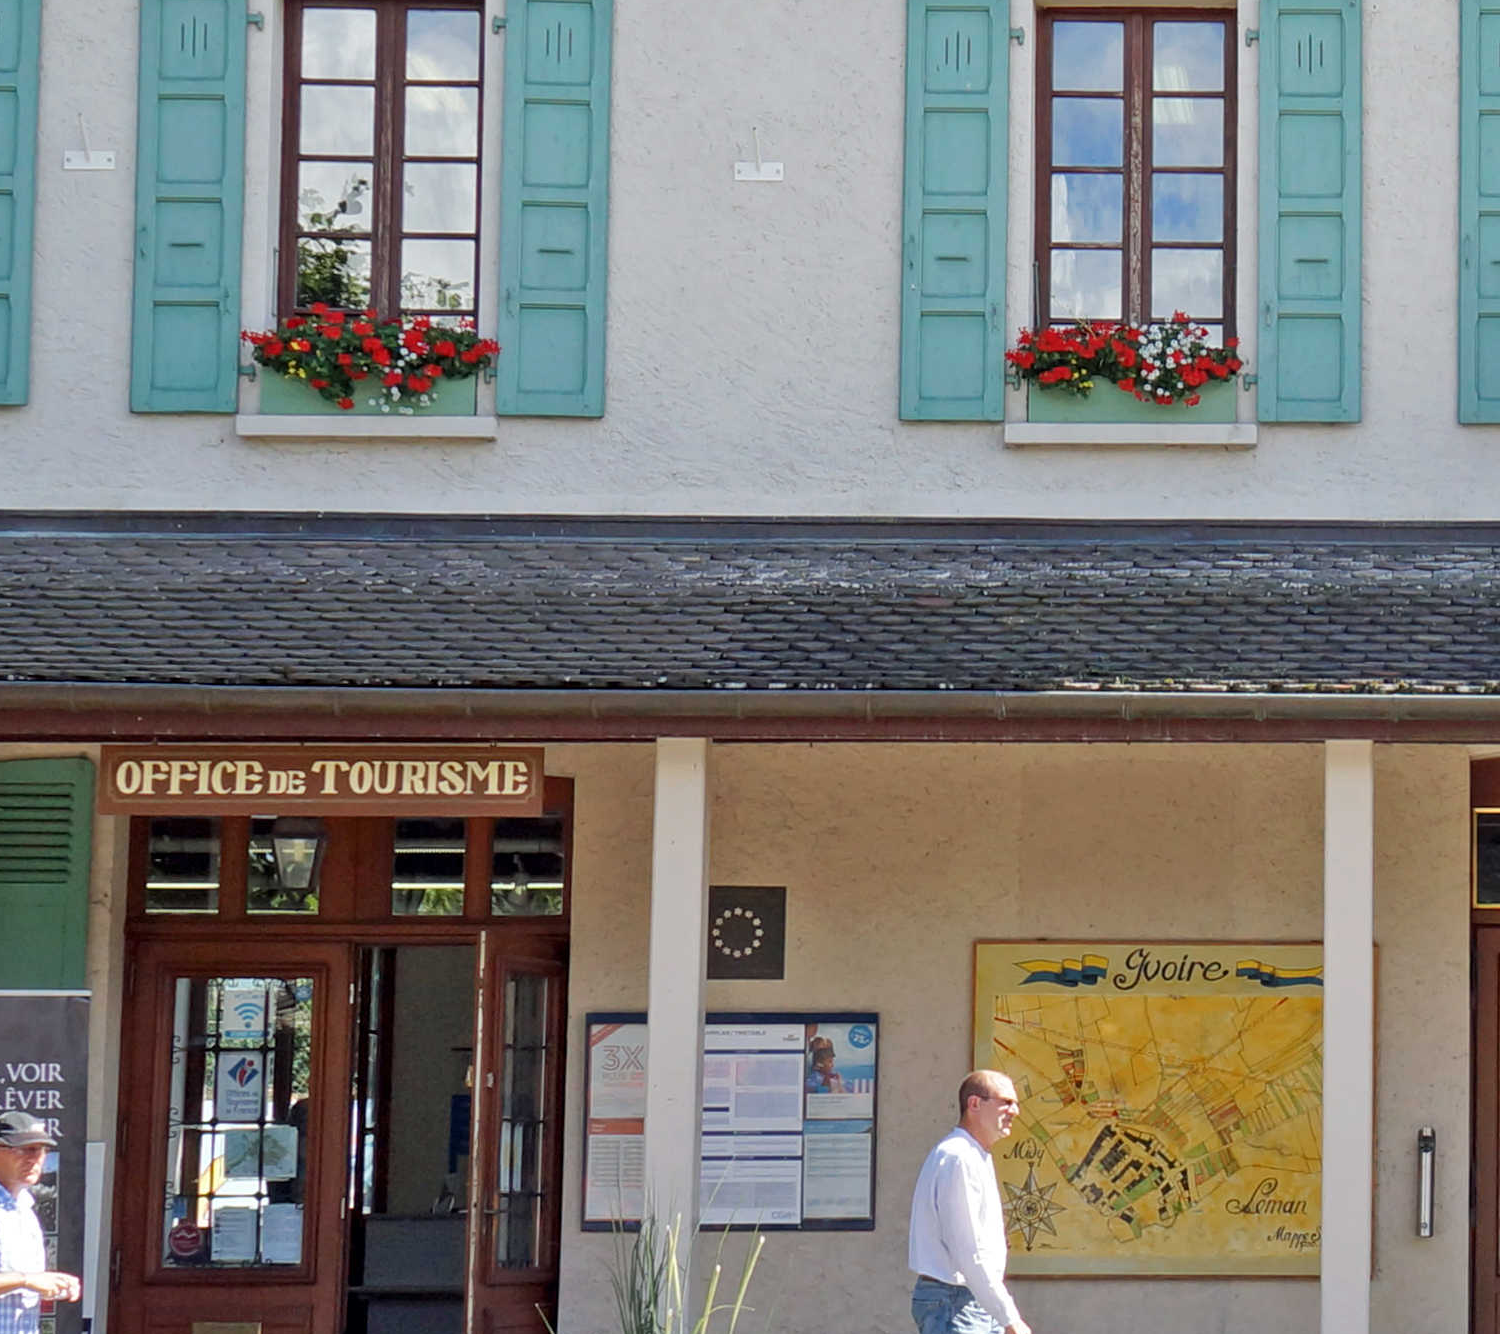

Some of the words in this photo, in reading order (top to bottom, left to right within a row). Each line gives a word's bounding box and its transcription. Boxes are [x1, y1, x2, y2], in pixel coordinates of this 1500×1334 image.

[115, 760, 263, 795] OFFICE
[267, 770, 306, 795] DE
[311, 760, 528, 795] TOURISME
[1113, 948, 1229, 990] Yvoire
[5, 1063, 65, 1083] VOIR
[601, 1045, 645, 1071] 3X
[1225, 1177, 1308, 1216] Léman
